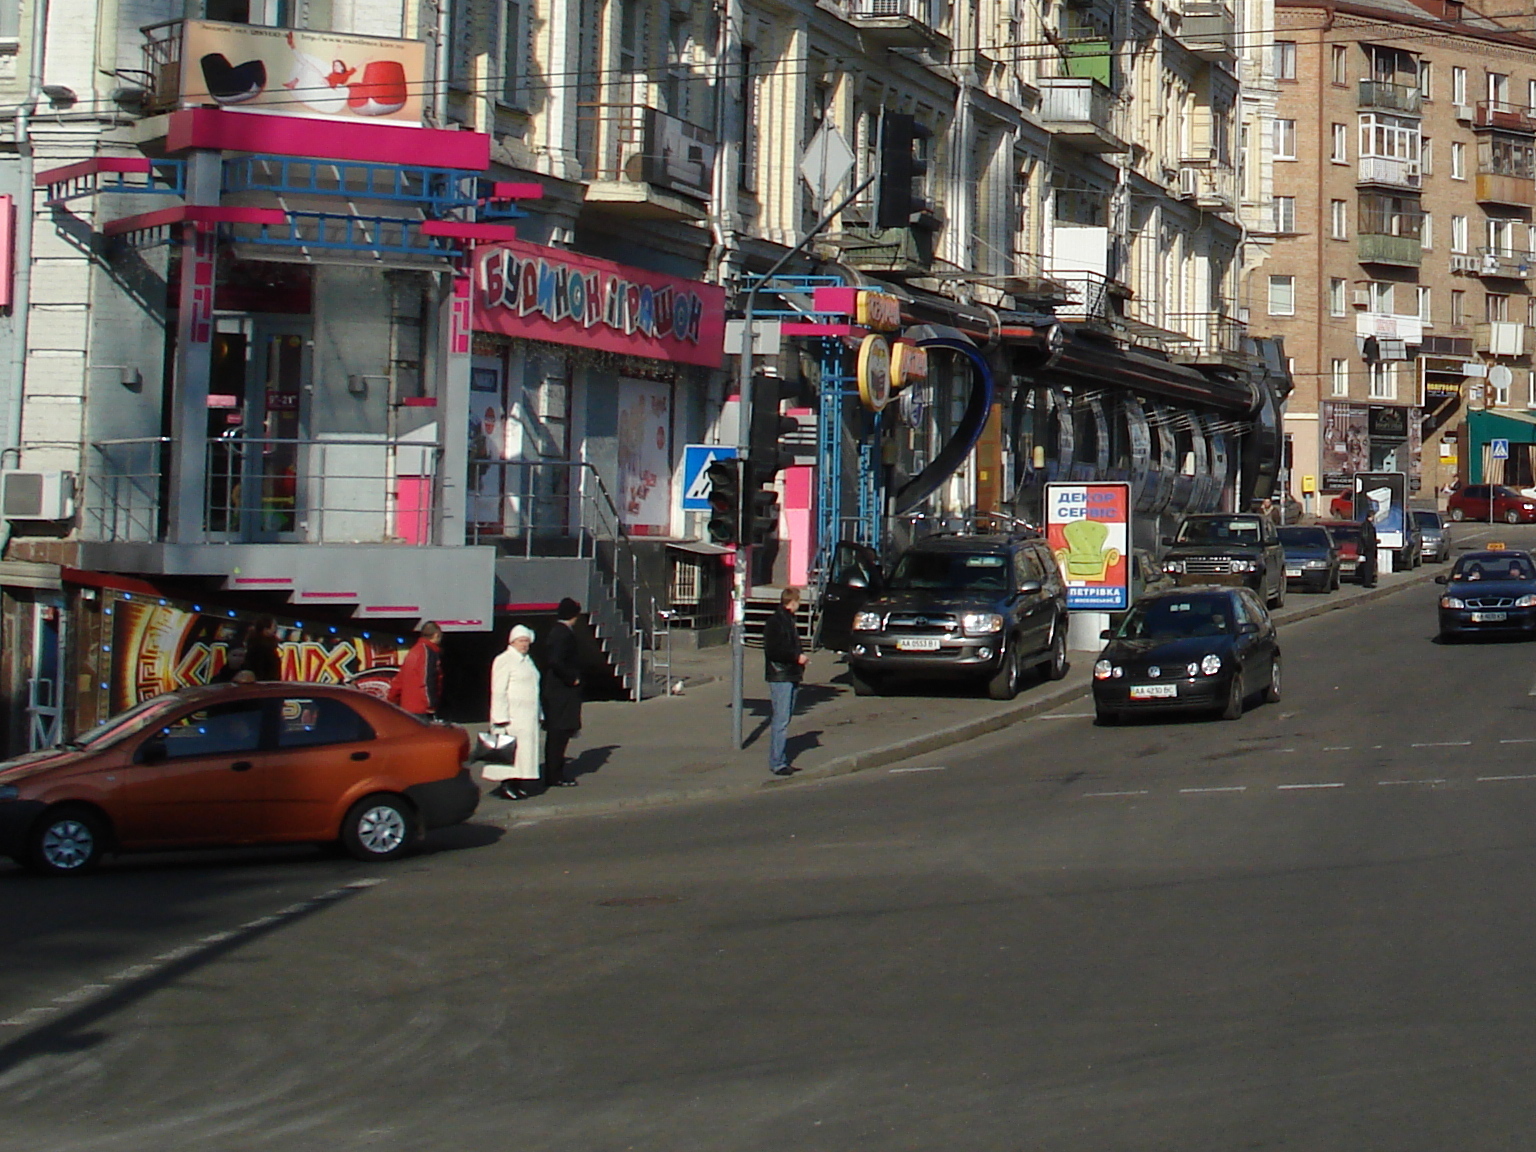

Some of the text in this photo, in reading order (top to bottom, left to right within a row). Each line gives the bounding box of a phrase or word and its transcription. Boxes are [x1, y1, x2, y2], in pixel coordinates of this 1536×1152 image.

[480, 248, 601, 329] БУДИНОК
[1058, 493, 1115, 504] ДЕКОР
[1057, 507, 1117, 518] СЕРВІС
[1069, 588, 1121, 596] ПЕТРІВКА
